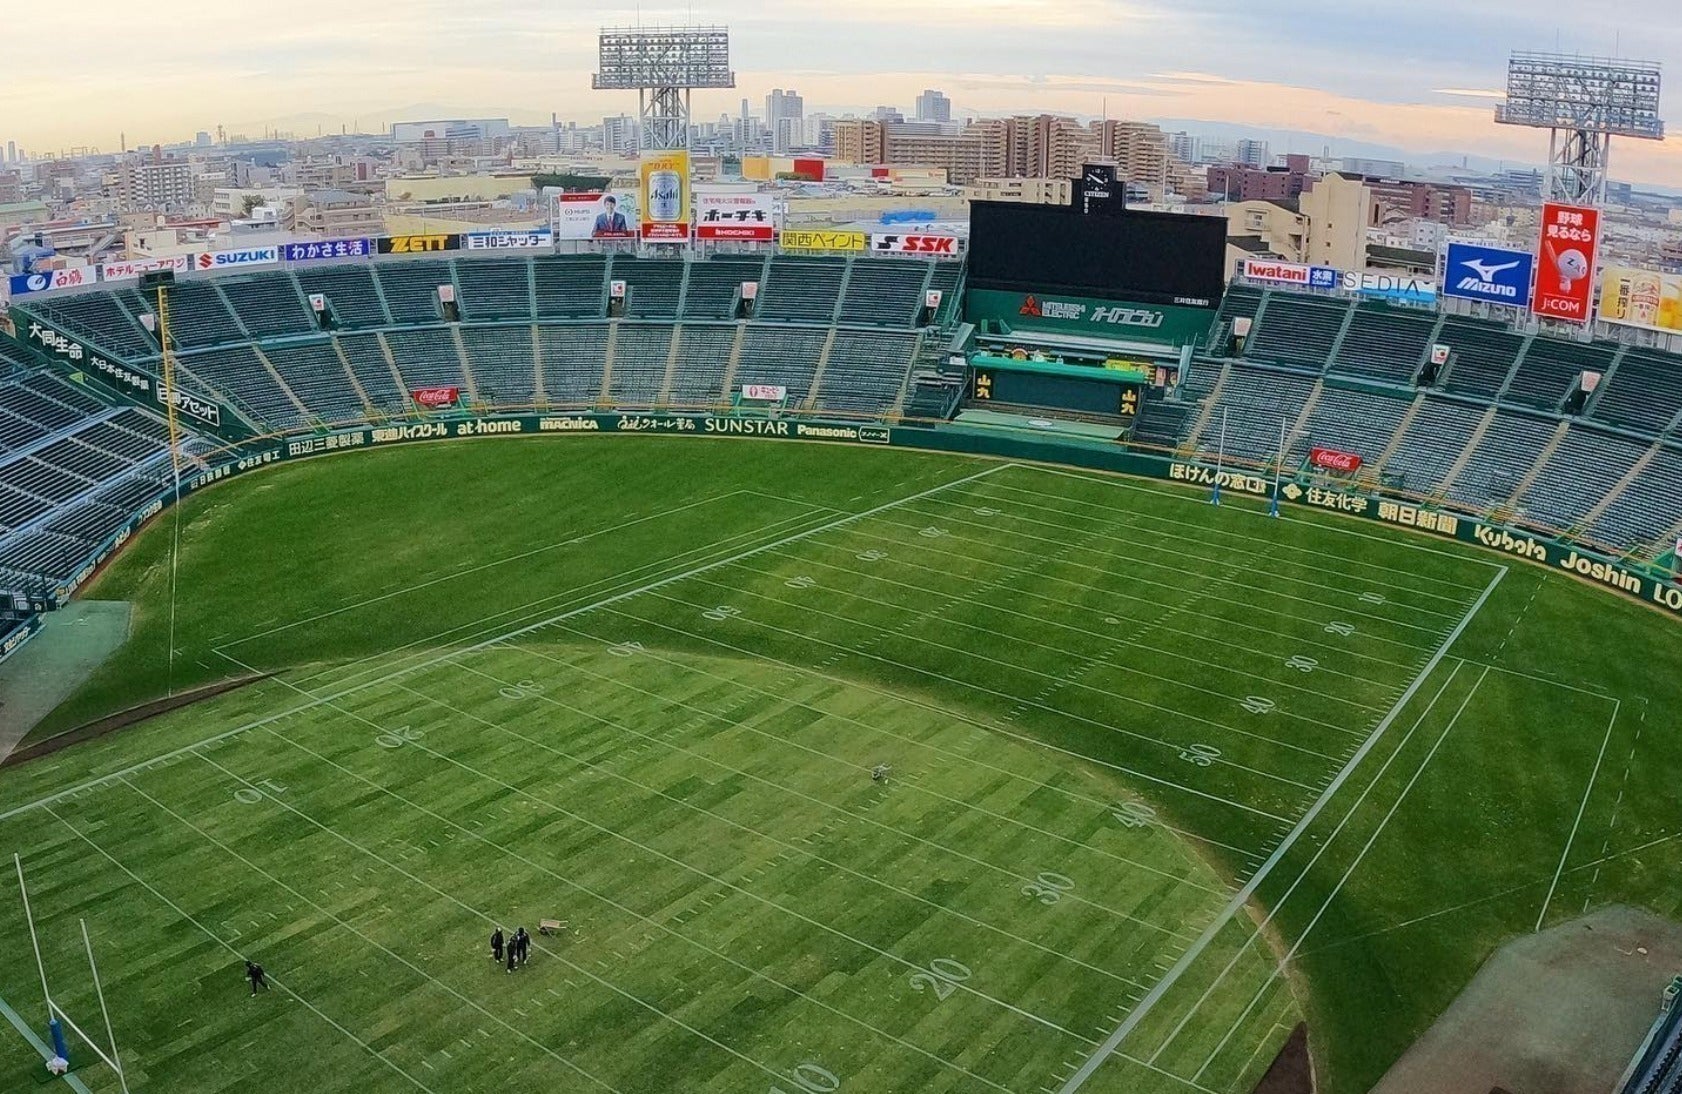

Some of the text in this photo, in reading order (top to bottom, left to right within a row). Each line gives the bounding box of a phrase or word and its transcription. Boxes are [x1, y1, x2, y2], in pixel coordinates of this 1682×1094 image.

[703, 209, 767, 222] ホーチキ
[1557, 211, 1584, 226] 野球
[472, 235, 547, 248] 三和シャッター
[782, 232, 863, 248] 関西ペイント
[1547, 224, 1592, 242] 見るなら
[291, 240, 364, 260] わかさ生活
[390, 235, 448, 253] ZETT
[902, 236, 955, 253] SSK
[215, 249, 275, 265] SUZUKI
[1248, 262, 1307, 282] Iwatani
[1343, 270, 1420, 296] SEDIA
[1456, 276, 1517, 297] MIZUNO
[1541, 298, 1580, 313] J:COM
[28, 321, 83, 360] 大同生命
[419, 389, 451, 402] Coca-Cola
[976, 374, 992, 399] 山九
[1121, 389, 1137, 415] 山九
[457, 419, 522, 436] at home
[704, 418, 789, 435] SUNSTAR
[797, 424, 858, 439] Panasonic
[1316, 450, 1351, 468] Coca-Cola
[1305, 486, 1368, 513] 住友化学
[1377, 501, 1458, 536] 朝日新聞
[1474, 523, 1547, 562] Kubota
[1560, 551, 1642, 594] Joshin
[1284, 654, 1319, 673] 30
[1179, 743, 1222, 767] 50
[1112, 802, 1157, 828] 40
[1020, 872, 1076, 906] 30
[909, 958, 973, 1002] 20
